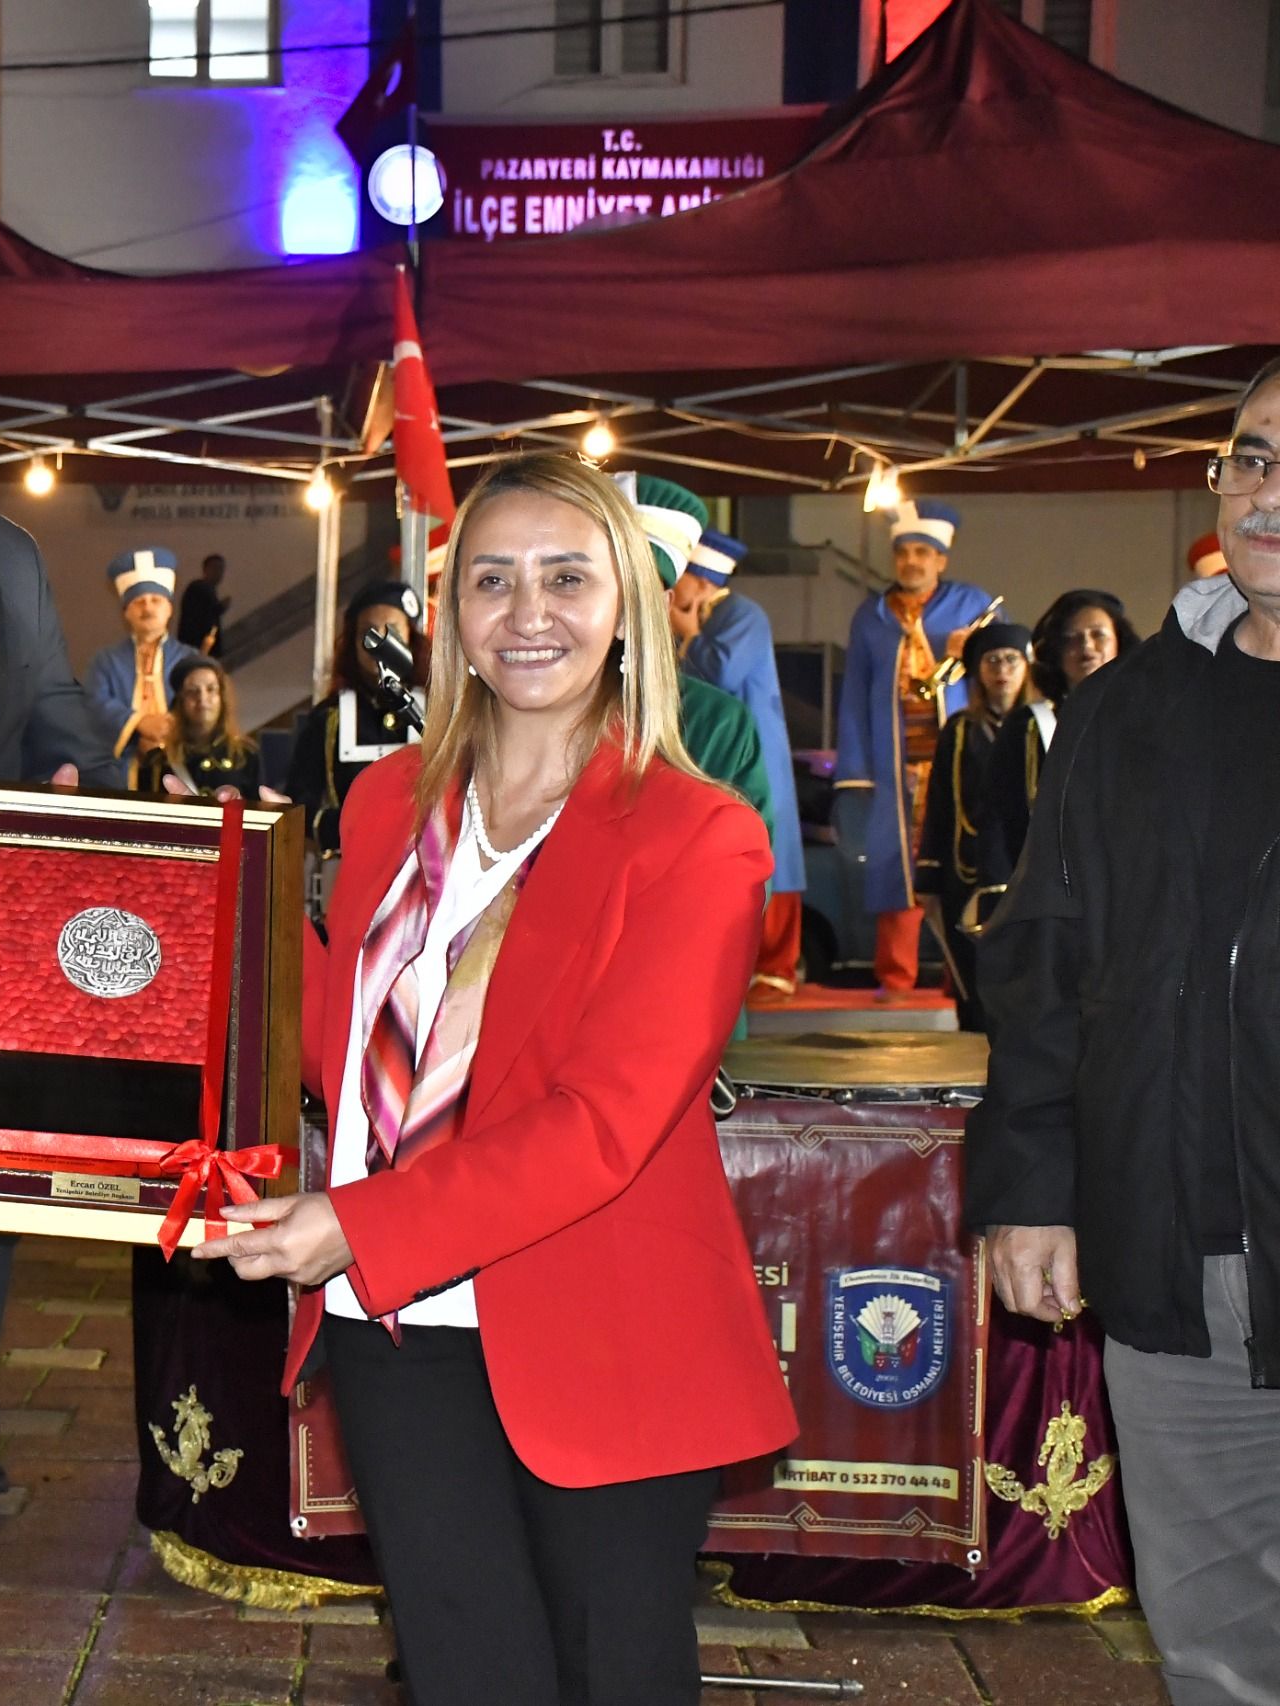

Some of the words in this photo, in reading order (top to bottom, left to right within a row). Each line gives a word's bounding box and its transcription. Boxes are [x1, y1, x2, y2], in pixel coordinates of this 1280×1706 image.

[602, 129, 643, 152] T.C.
[480, 152, 596, 180] PAZARYERİ
[602, 153, 764, 179] KAYMAKAMLIĞI
[453, 187, 517, 242] İLÇE
[70, 1180, 96, 1190] Ercan
[97, 1181, 122, 1192] ÖZEL
[837, 1364, 899, 1402] BELEDİYESİ
[902, 1359, 942, 1400] OSMANLI
[931, 1299, 945, 1356] MEHTERİ
[840, 1474, 849, 1484] 0
[852, 1473, 878, 1485] 532
[880, 1474, 906, 1486] 370
[909, 1475, 928, 1488] 44
[931, 1477, 951, 1489] 48
